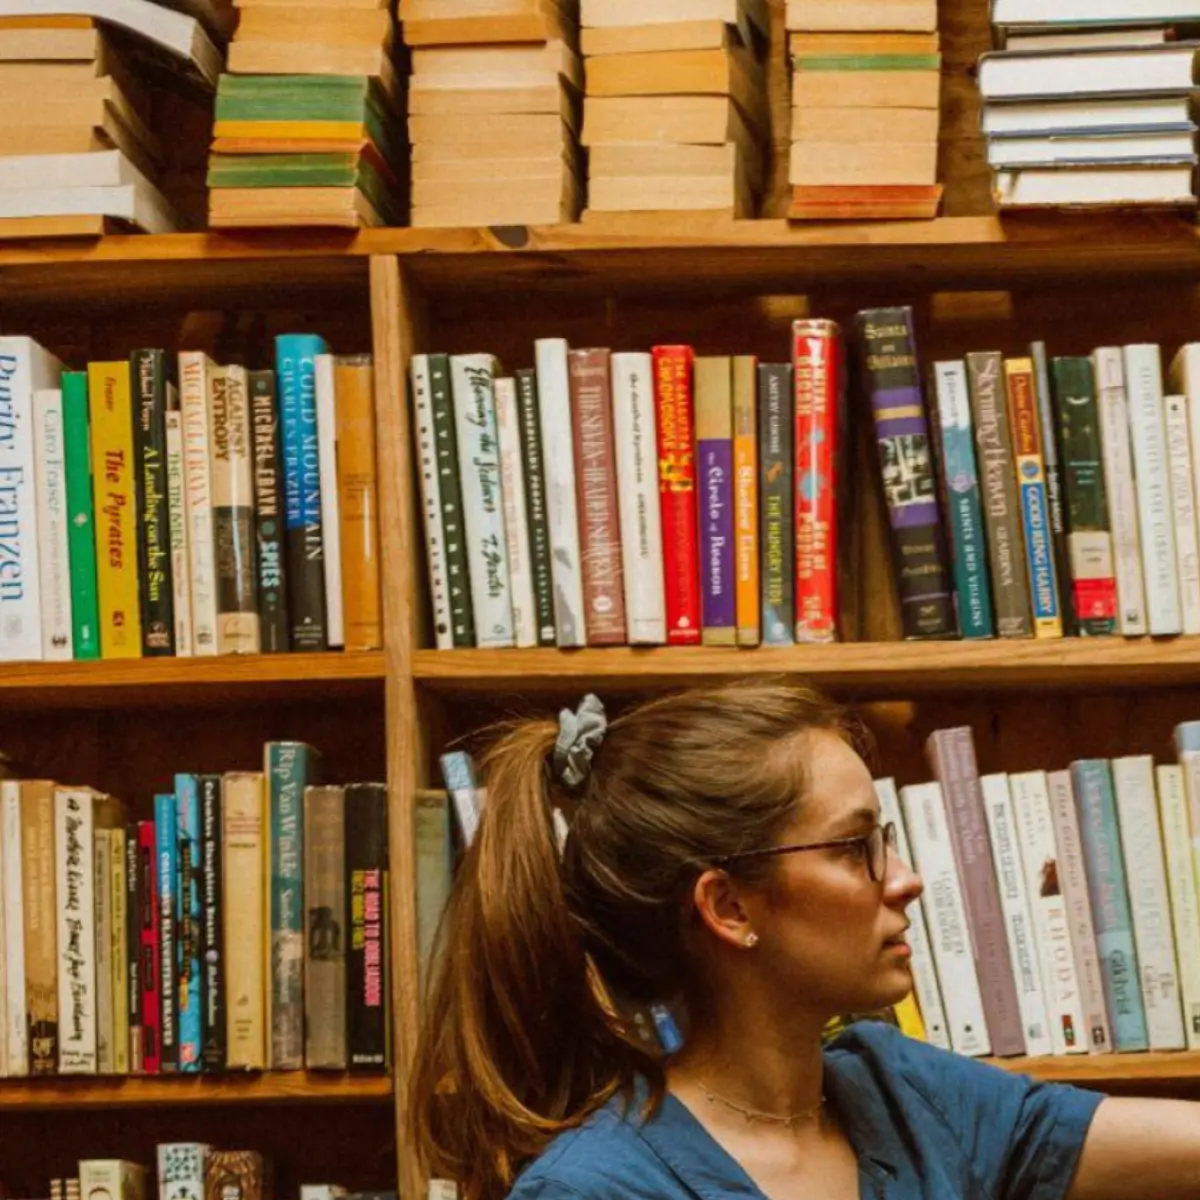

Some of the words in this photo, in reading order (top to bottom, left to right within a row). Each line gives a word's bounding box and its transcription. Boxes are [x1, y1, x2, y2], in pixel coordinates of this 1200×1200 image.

[0, 354, 22, 448] Purity
[104, 376, 117, 411] Fraser
[139, 353, 158, 398] Michael
[282, 357, 296, 440] CHARLES
[299, 357, 320, 423] COLD
[464, 366, 491, 427] Elbowing
[977, 358, 1001, 444] Storming
[139, 399, 154, 431] Frayn
[182, 360, 202, 444] MICHAEL
[212, 378, 229, 462] ENTROPY
[228, 378, 246, 458] AGAINST
[659, 357, 676, 450] CHROMOSOME
[676, 384, 689, 450] CALCUTTA
[44, 409, 59, 454] Caro
[143, 446, 156, 459] A
[254, 396, 274, 462] MICHAEL
[480, 433, 494, 453] the
[46, 459, 61, 515] Fraser
[105, 449, 125, 482] The
[168, 452, 181, 479] THE
[187, 451, 206, 507] FRAYN
[257, 468, 276, 515] FRAYN
[285, 450, 301, 520] FRAZIER
[474, 457, 499, 514] Seducer
[984, 449, 1010, 518] Heaven
[143, 463, 162, 521] Landing
[169, 485, 182, 511] TIN
[301, 433, 321, 561] MOUNTAIN
[432, 371, 452, 476] SYLVIE
[444, 504, 465, 634] GERMAIN
[532, 475, 543, 520] PEOPLE
[708, 467, 723, 519] Circle
[738, 465, 753, 530] Shadow
[767, 494, 780, 516] THE
[1027, 486, 1041, 526] GOOD
[0, 466, 29, 601] Franzen
[104, 492, 127, 568] Pyrates
[171, 513, 184, 549] MEN
[959, 498, 974, 541] SAINTS
[149, 549, 166, 570] the
[261, 541, 279, 587] SPIES
[711, 535, 725, 595] Reason
[740, 534, 753, 581] Lines
[768, 521, 782, 572] HUNGRY
[963, 544, 978, 571] AND
[997, 526, 1012, 586] GIARDINA
[1032, 530, 1045, 563] KING
[149, 571, 165, 602] Sun
[770, 577, 782, 605] TIDE
[968, 577, 983, 627] VILLAINS
[1035, 567, 1051, 613] HARRY
[277, 748, 296, 779] Rip
[204, 781, 214, 837] Columbus
[280, 783, 297, 812] Van
[205, 841, 216, 903] Slaughters
[279, 814, 298, 878] Winkle
[161, 852, 172, 914] COLUMBUS
[366, 869, 379, 888] THE
[366, 892, 380, 919] ROAD
[366, 923, 380, 938] TO
[161, 918, 174, 995] SLAUGHTERS
[1049, 908, 1074, 1001] RHODA
[1110, 950, 1131, 1016] Gilchrist
[162, 998, 174, 1045] BRAVES
